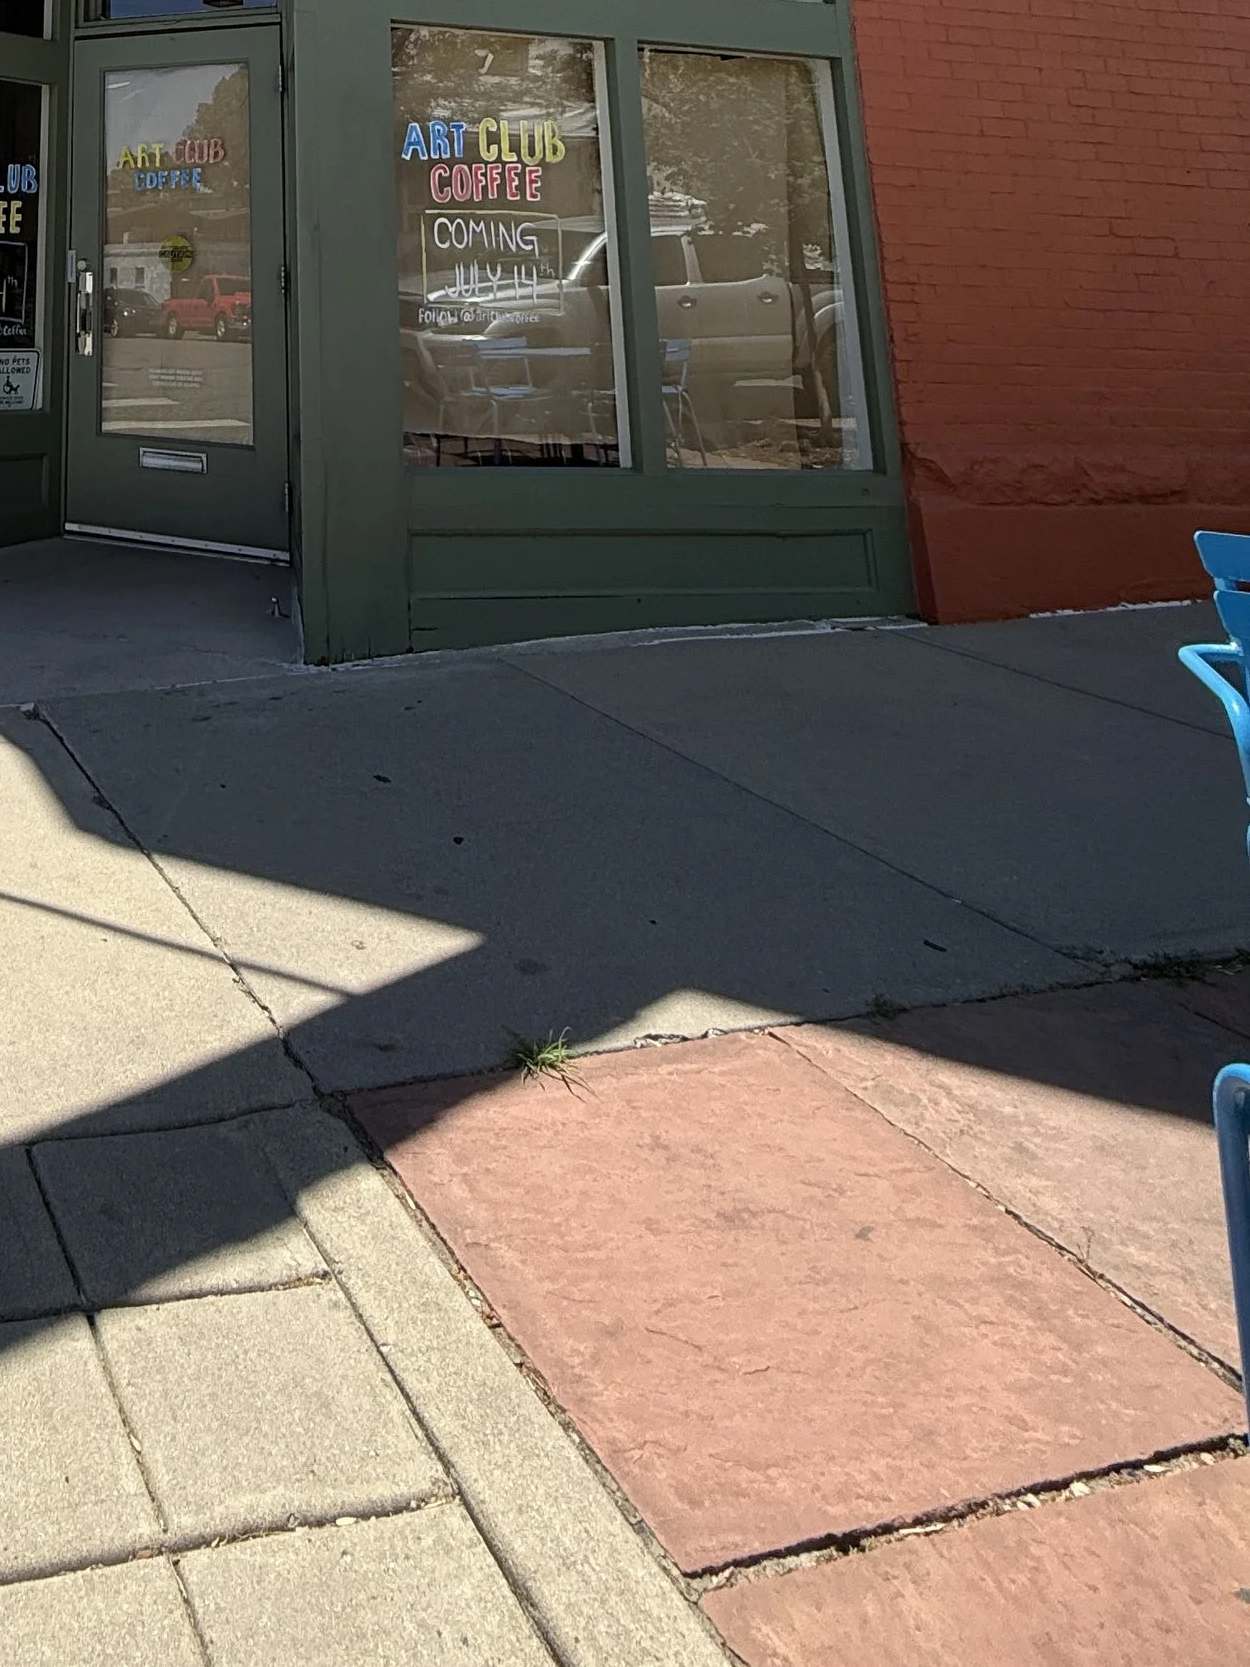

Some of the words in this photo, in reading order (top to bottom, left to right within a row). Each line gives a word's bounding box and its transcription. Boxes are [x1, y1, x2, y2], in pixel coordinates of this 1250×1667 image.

[116, 142, 165, 170] ART
[172, 136, 225, 164] CLUB
[401, 119, 467, 161] ART
[478, 117, 566, 166] CLUB
[133, 167, 202, 191] COFFEE
[430, 163, 542, 203] COFFEE
[433, 217, 540, 259] COMING
[444, 259, 502, 300] JULY
[12, 357, 30, 365] PETS
